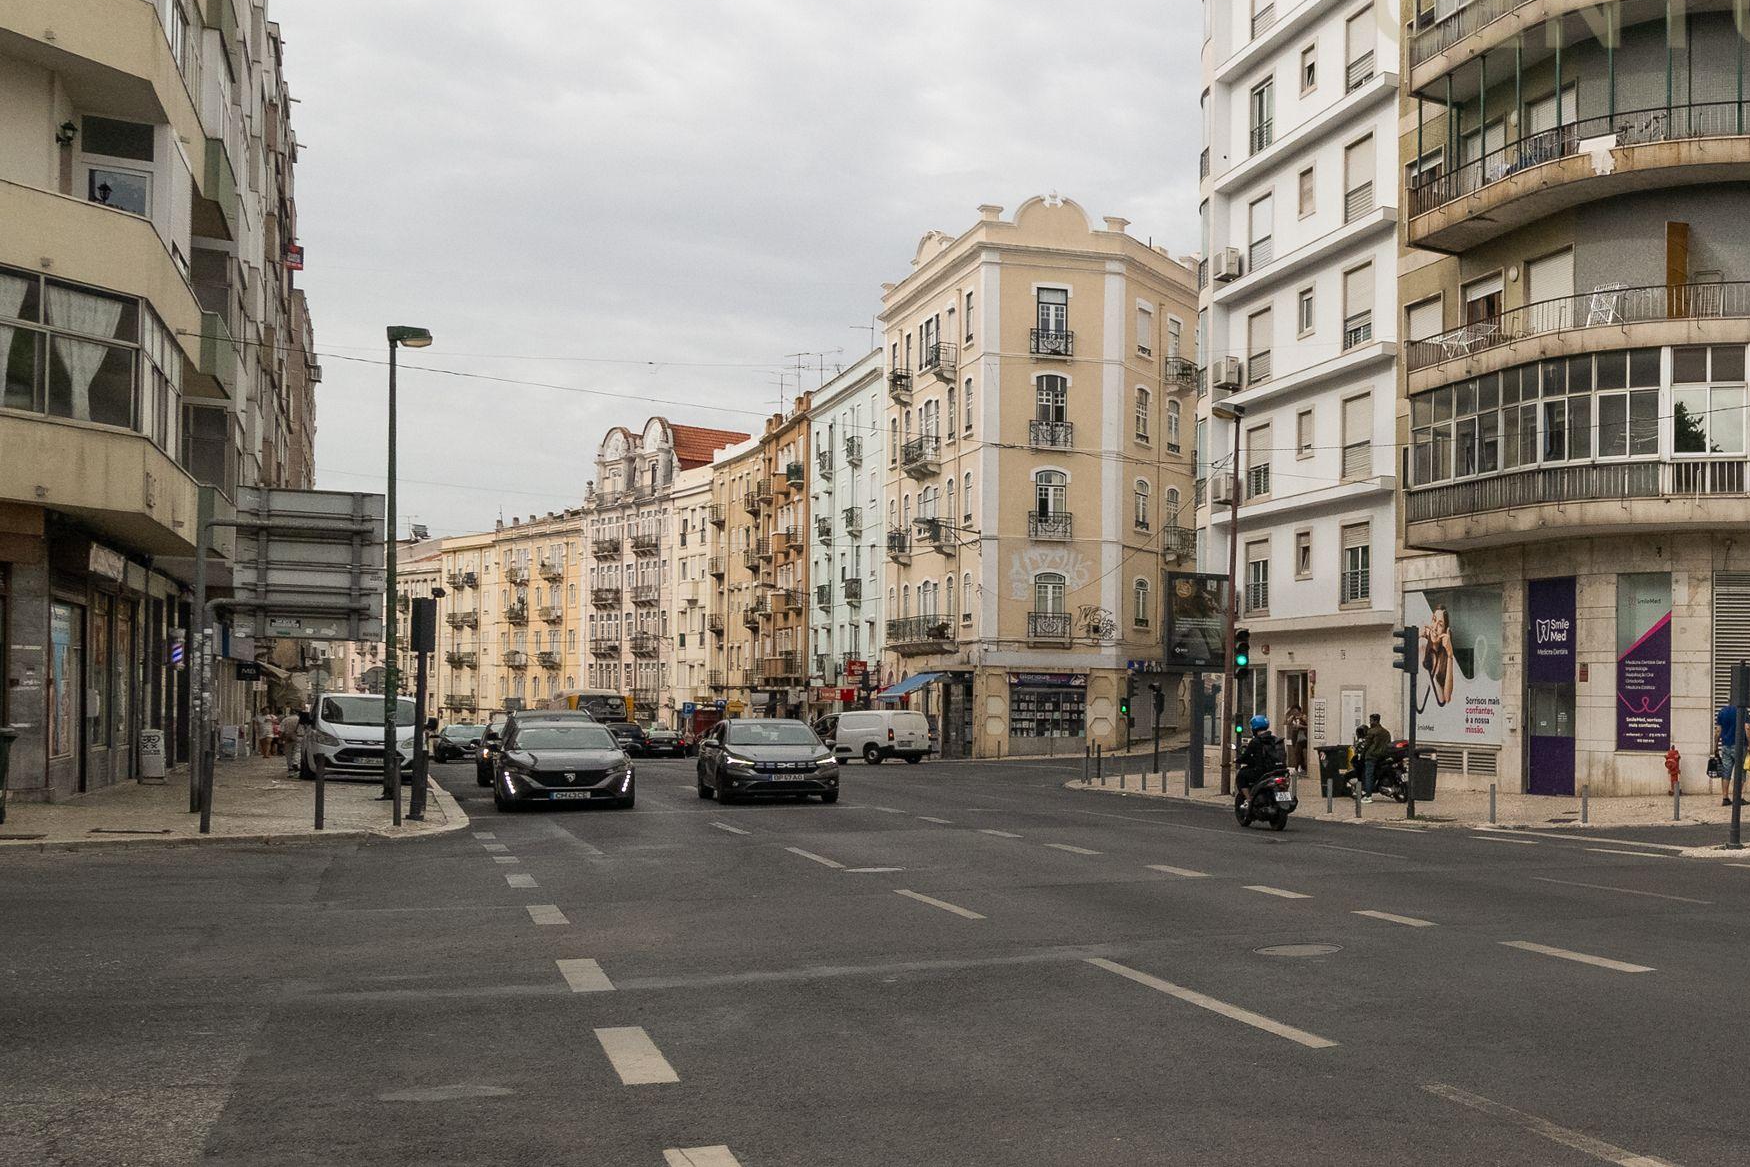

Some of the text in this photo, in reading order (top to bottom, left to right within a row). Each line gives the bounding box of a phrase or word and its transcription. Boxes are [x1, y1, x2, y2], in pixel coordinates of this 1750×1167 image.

[1551, 618, 1570, 630] Smile
[1551, 630, 1567, 641] Med
[1465, 696, 1500, 705] Sorrisos mais
[1465, 726, 1485, 734] missão.
